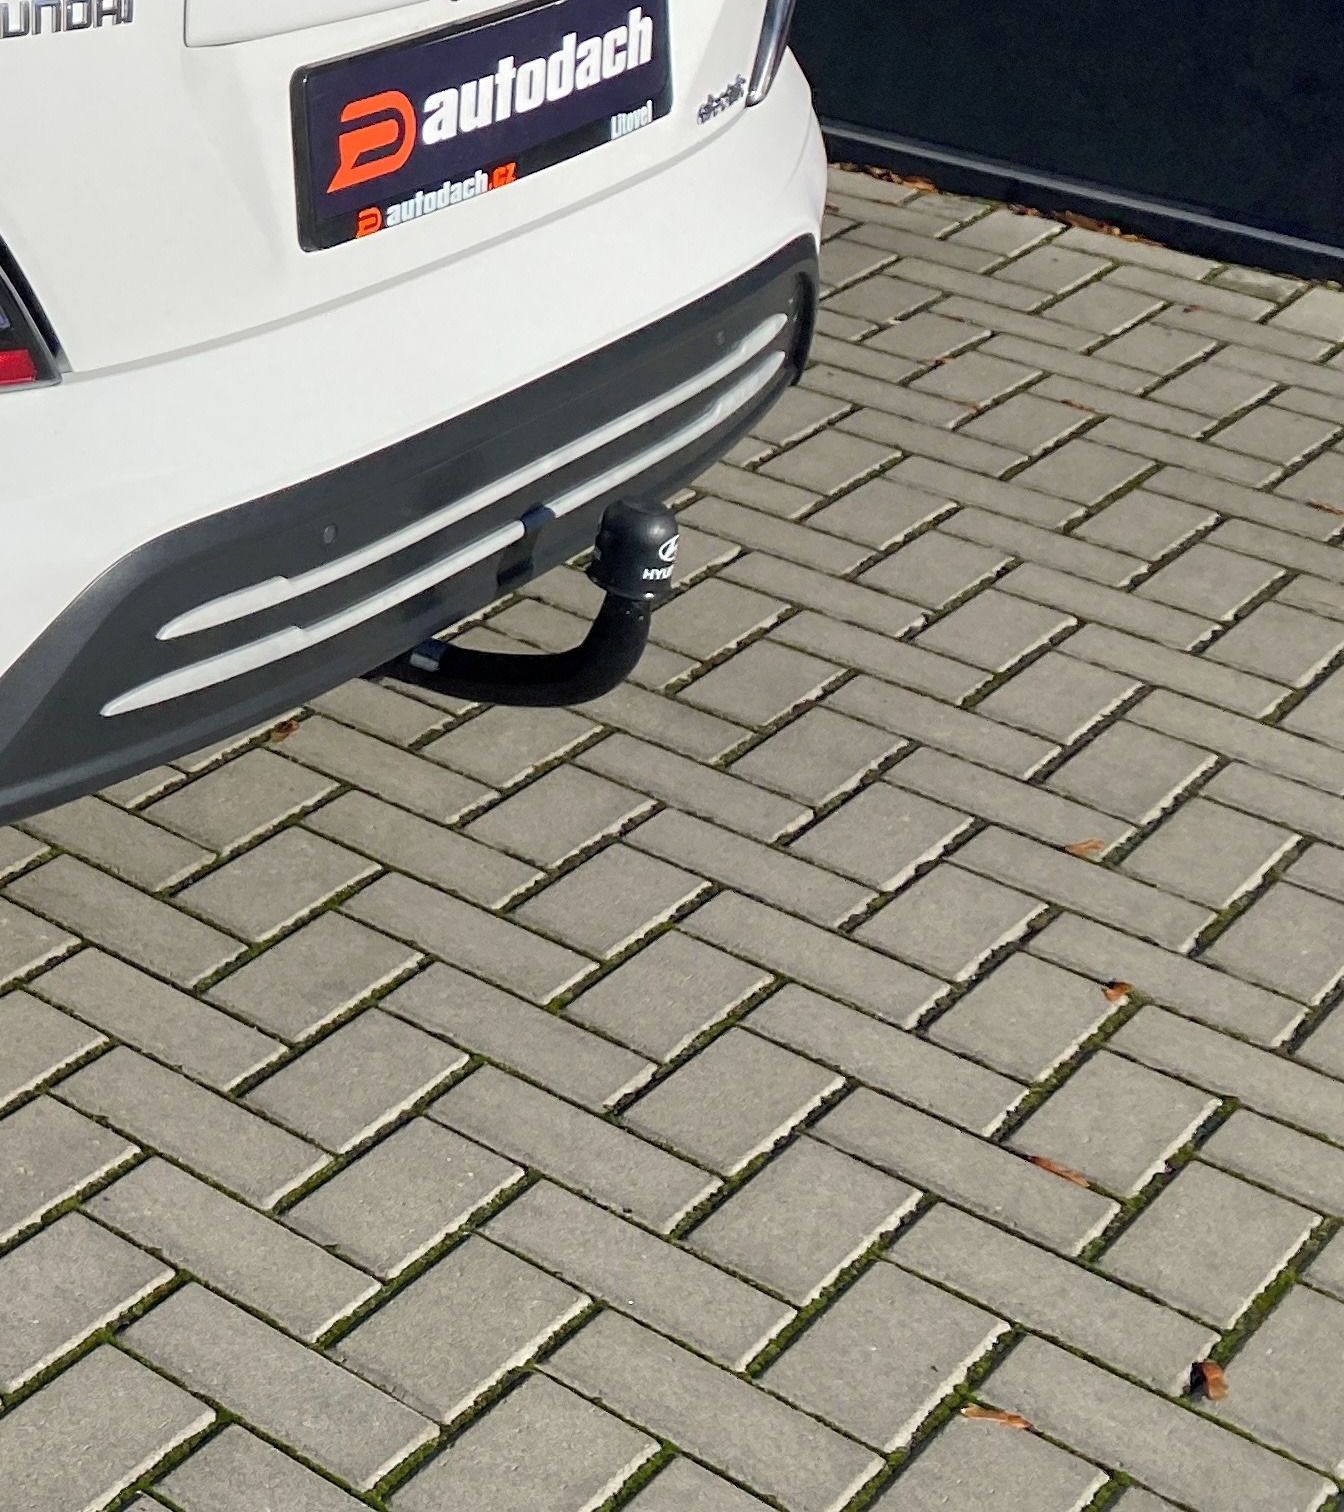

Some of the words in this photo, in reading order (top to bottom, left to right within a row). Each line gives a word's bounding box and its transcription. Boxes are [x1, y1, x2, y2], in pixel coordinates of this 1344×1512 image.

[422, 6, 653, 145] autodach
[610, 99, 653, 141] Litovel
[386, 162, 516, 228] autodach.cz
